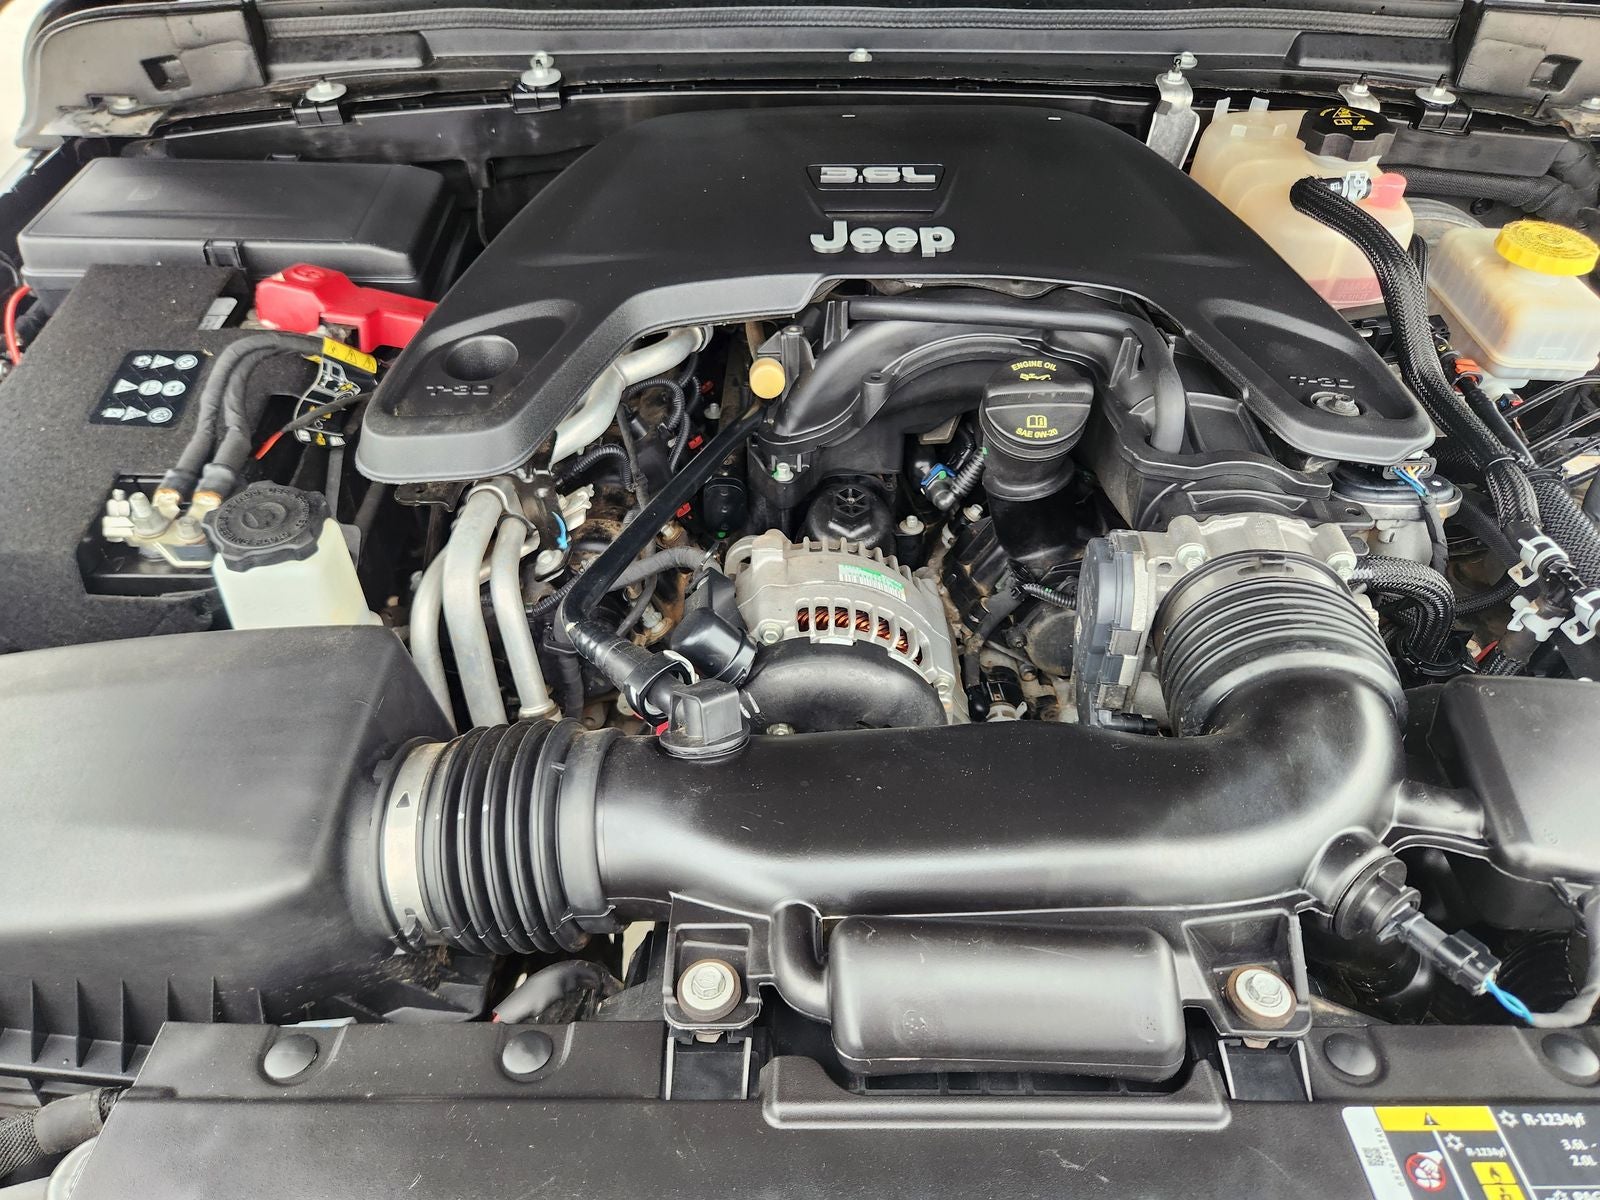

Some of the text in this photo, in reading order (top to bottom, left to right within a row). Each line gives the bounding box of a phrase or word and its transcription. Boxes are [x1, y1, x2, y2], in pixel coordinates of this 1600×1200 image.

[820, 166, 936, 184] 3.6L
[809, 220, 956, 258] Jeep
[1011, 360, 1058, 372] ENGINE OIL
[1015, 427, 1059, 439] SAE 0W-20
[1521, 1111, 1587, 1129] R-1234yf
[1560, 1138, 1589, 1152] 3.6L
